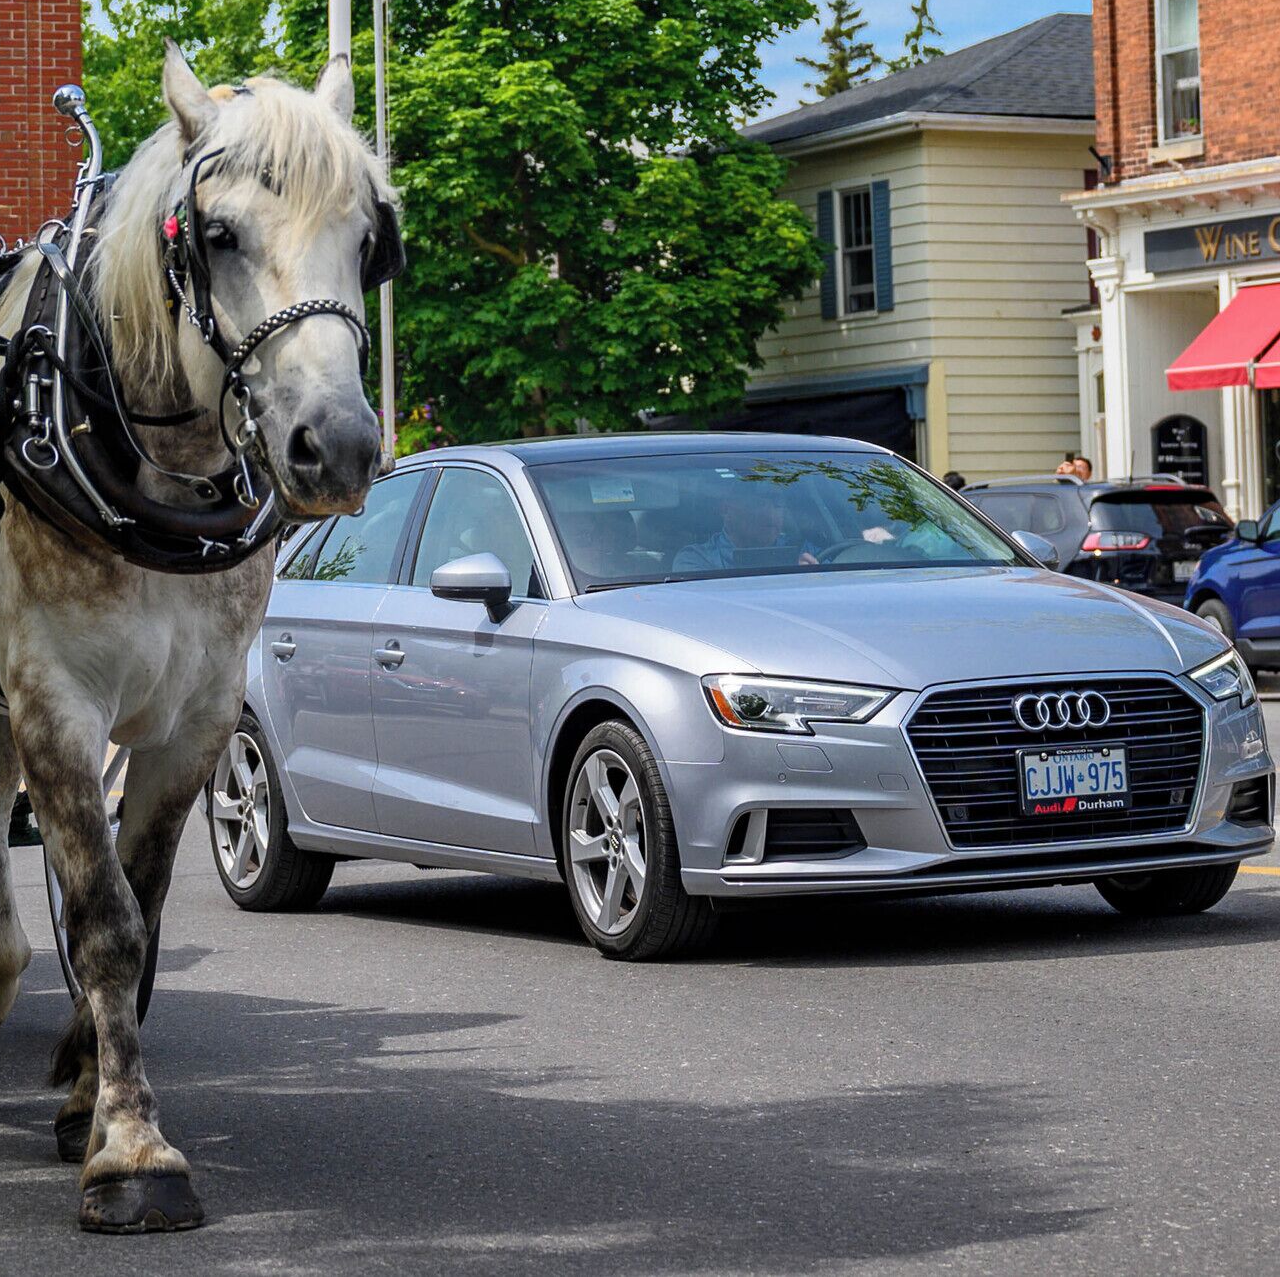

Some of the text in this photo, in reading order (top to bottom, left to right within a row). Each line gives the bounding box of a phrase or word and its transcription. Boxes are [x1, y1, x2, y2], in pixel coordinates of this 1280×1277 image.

[1195, 224, 1261, 261] WINE
[1052, 753, 1094, 764] ONTARIO
[1026, 761, 1124, 797] CJJW 975
[1034, 799, 1124, 814] Audi Durham
